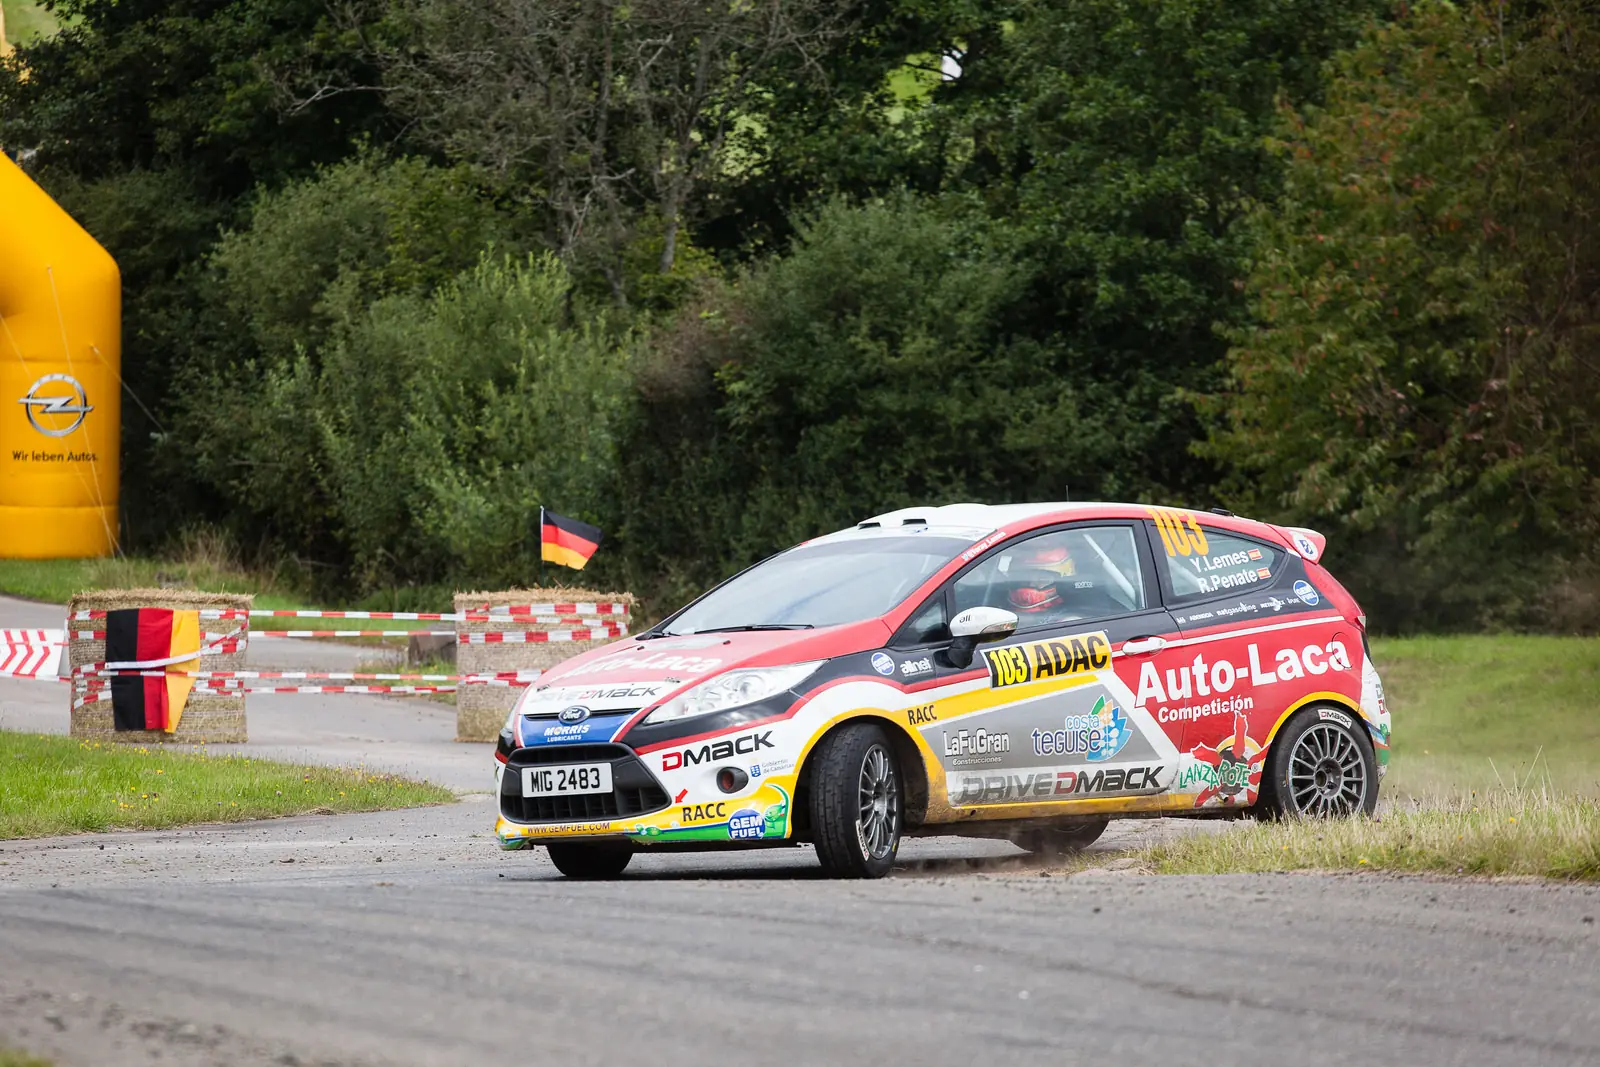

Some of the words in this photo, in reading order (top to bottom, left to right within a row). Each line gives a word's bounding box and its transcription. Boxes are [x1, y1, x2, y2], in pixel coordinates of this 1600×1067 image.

[12, 451, 29, 461] Wir
[32, 451, 64, 461] leben
[1145, 508, 1209, 557] 103
[1189, 550, 1249, 573] Y.Lemes
[1197, 569, 1258, 593] R.Penate
[989, 650, 1029, 686] 103
[1035, 635, 1108, 679] ADAC
[1135, 640, 1352, 708] Auto-Laca
[563, 707, 582, 719] Ford
[907, 705, 937, 726] RACC
[1158, 695, 1254, 723] Competición
[544, 724, 591, 736] MORRIS
[1065, 714, 1100, 729] costa
[662, 730, 775, 771] DMACK
[943, 728, 1010, 757] LaFuGran
[952, 756, 1003, 766] Construcciones
[530, 770, 553, 793] MIG
[557, 768, 601, 791] 2483
[1179, 760, 1251, 791] LANZAROTE
[682, 802, 726, 822] RACC
[729, 816, 763, 829] GEM
[527, 822, 611, 835] WWW.GEMFUEL.COM
[730, 827, 763, 839] FUEL
